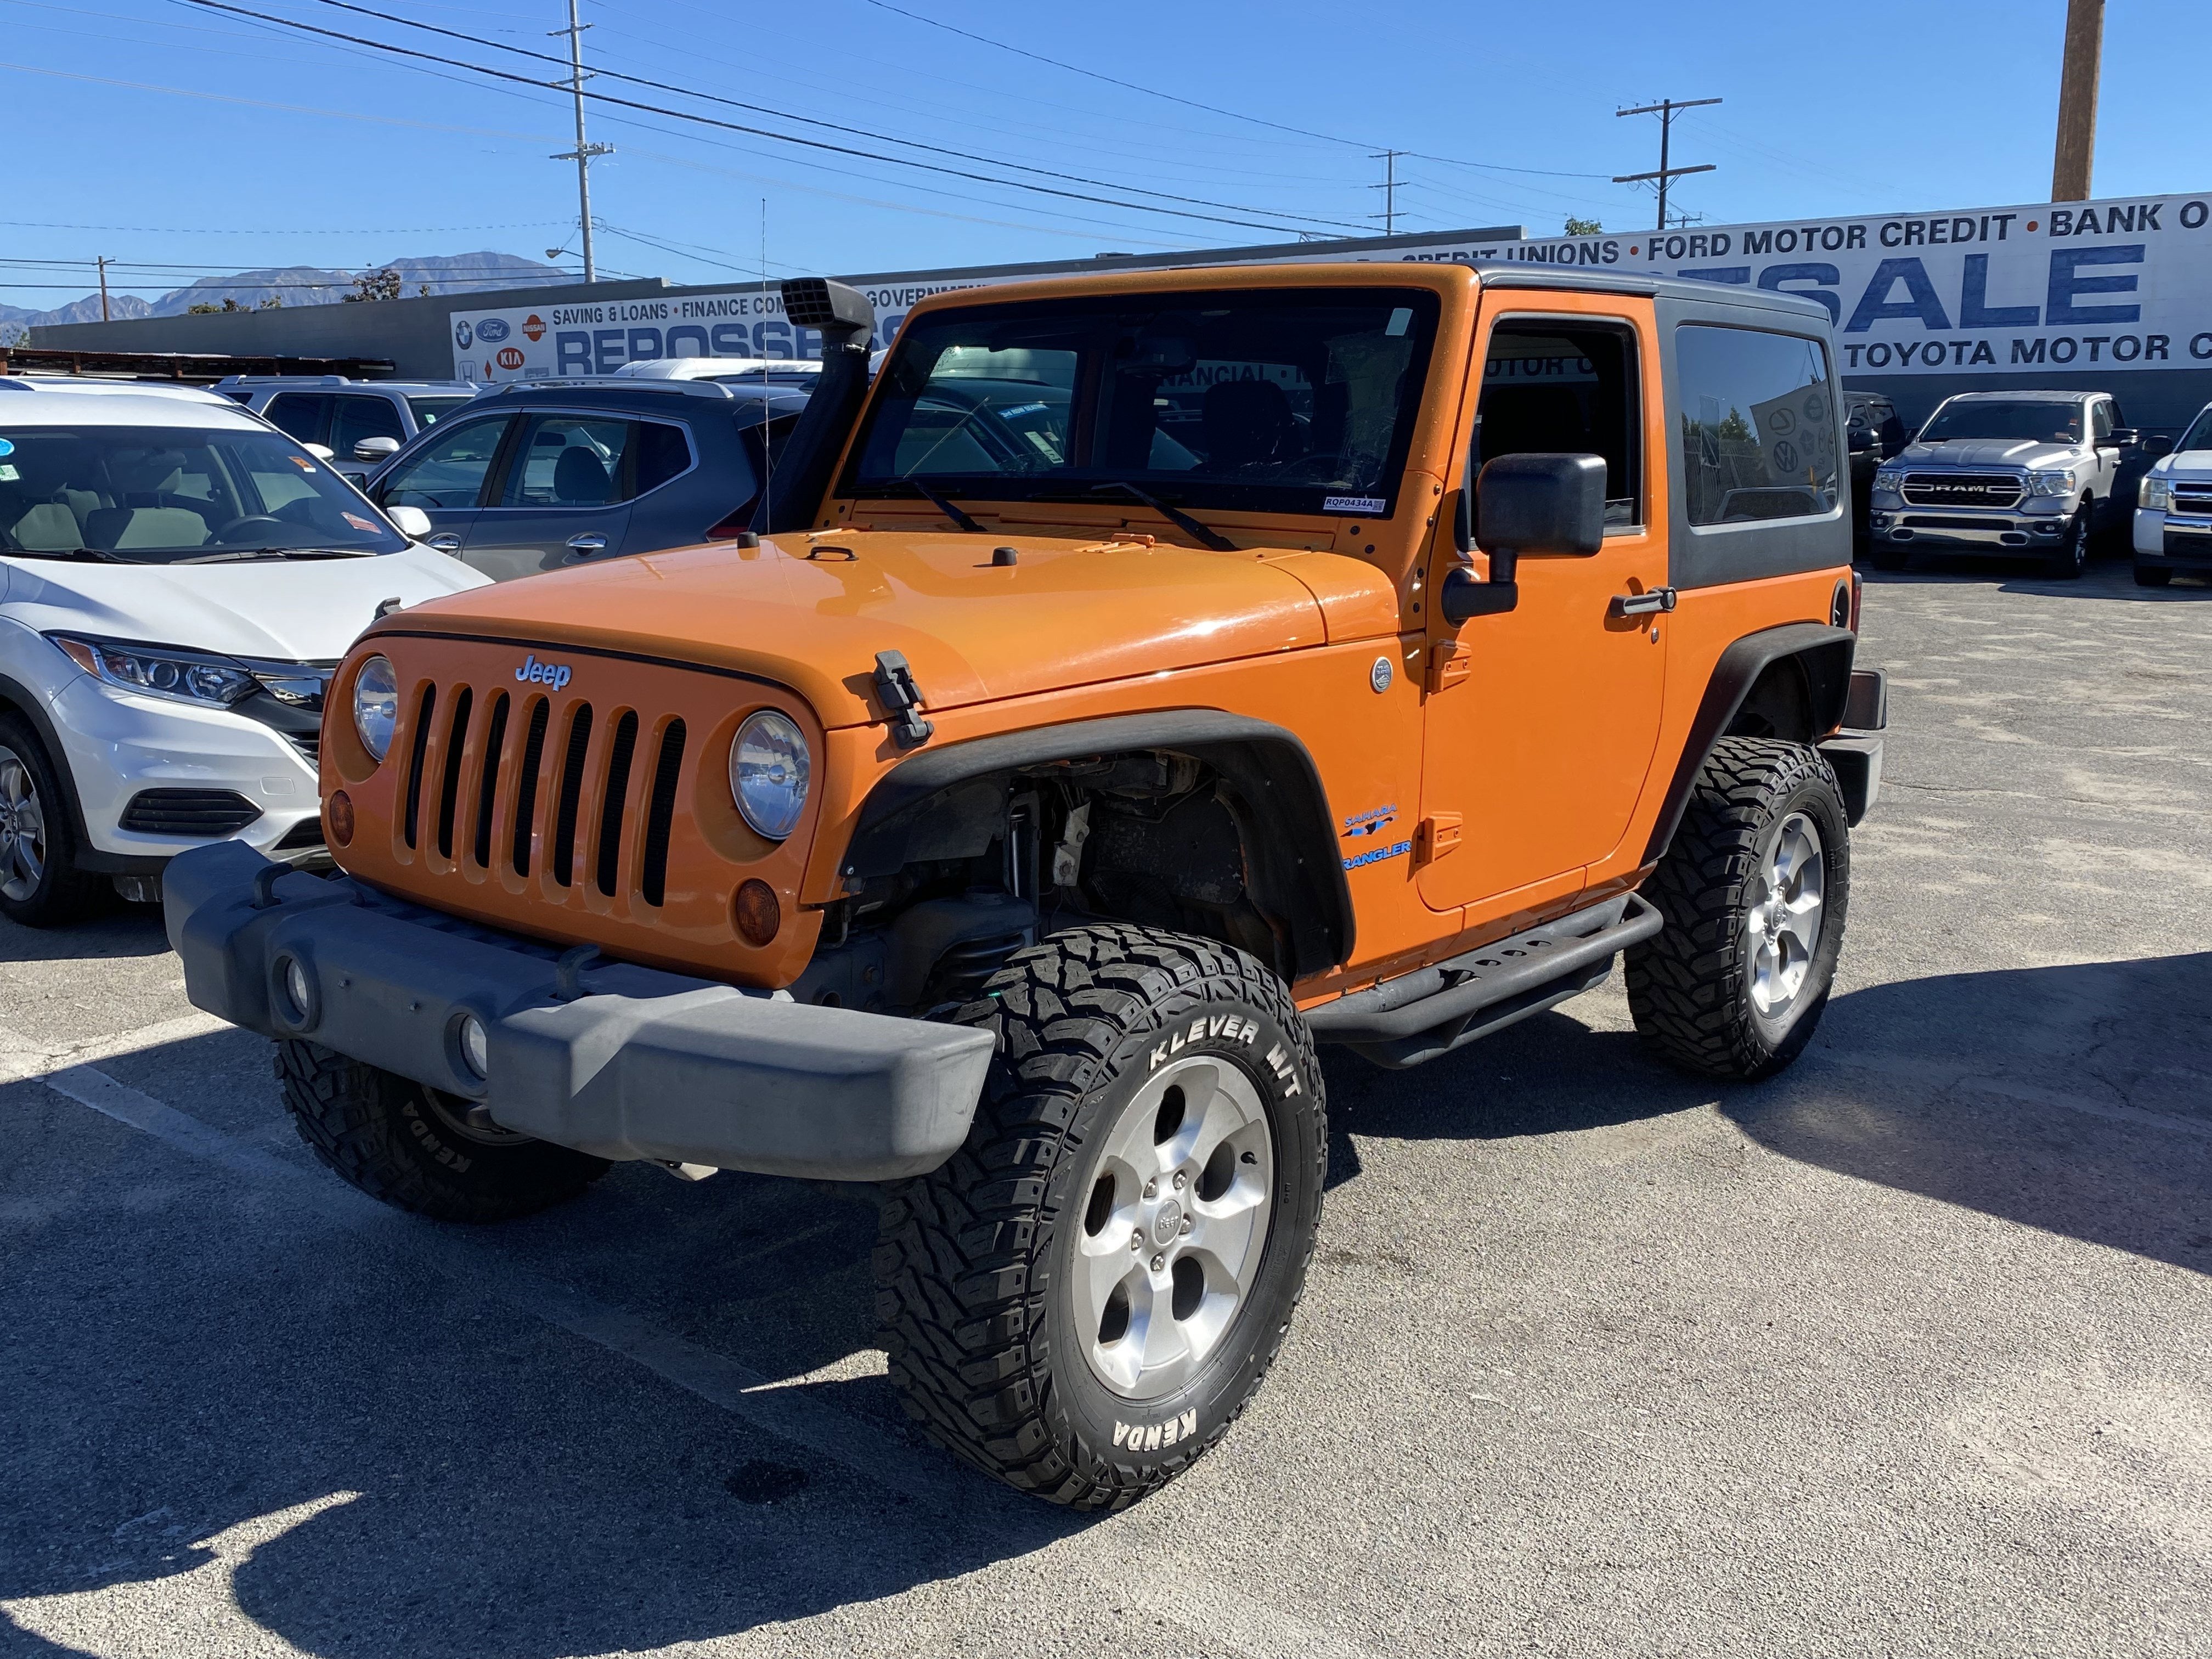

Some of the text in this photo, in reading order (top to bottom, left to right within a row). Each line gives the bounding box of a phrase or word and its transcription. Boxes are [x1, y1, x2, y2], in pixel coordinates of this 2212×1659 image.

[2049, 201, 2212, 238] BANK O
[1649, 213, 2017, 261] FORD MOTOR CREDIT
[553, 303, 668, 325] SAVING & LOANS
[682, 296, 786, 318] FINANCE COM
[483, 323, 503, 337] Ford
[523, 324, 545, 332] NISSAN
[500, 352, 522, 365] KIA
[556, 315, 906, 376] REPOSSE
[1844, 332, 2212, 368] TOYOTA MOTOR C
[1485, 357, 1564, 377] OTOR
[1325, 498, 1373, 507] RQP0434A
[515, 654, 572, 692] Jeep
[1344, 803, 1397, 827] SAHARA
[1342, 840, 1412, 870] RANGLER
[1150, 1014, 1260, 1070] KLEVER
[403, 1101, 472, 1173] KENDA
[1113, 1408, 1197, 1452] KENDA
